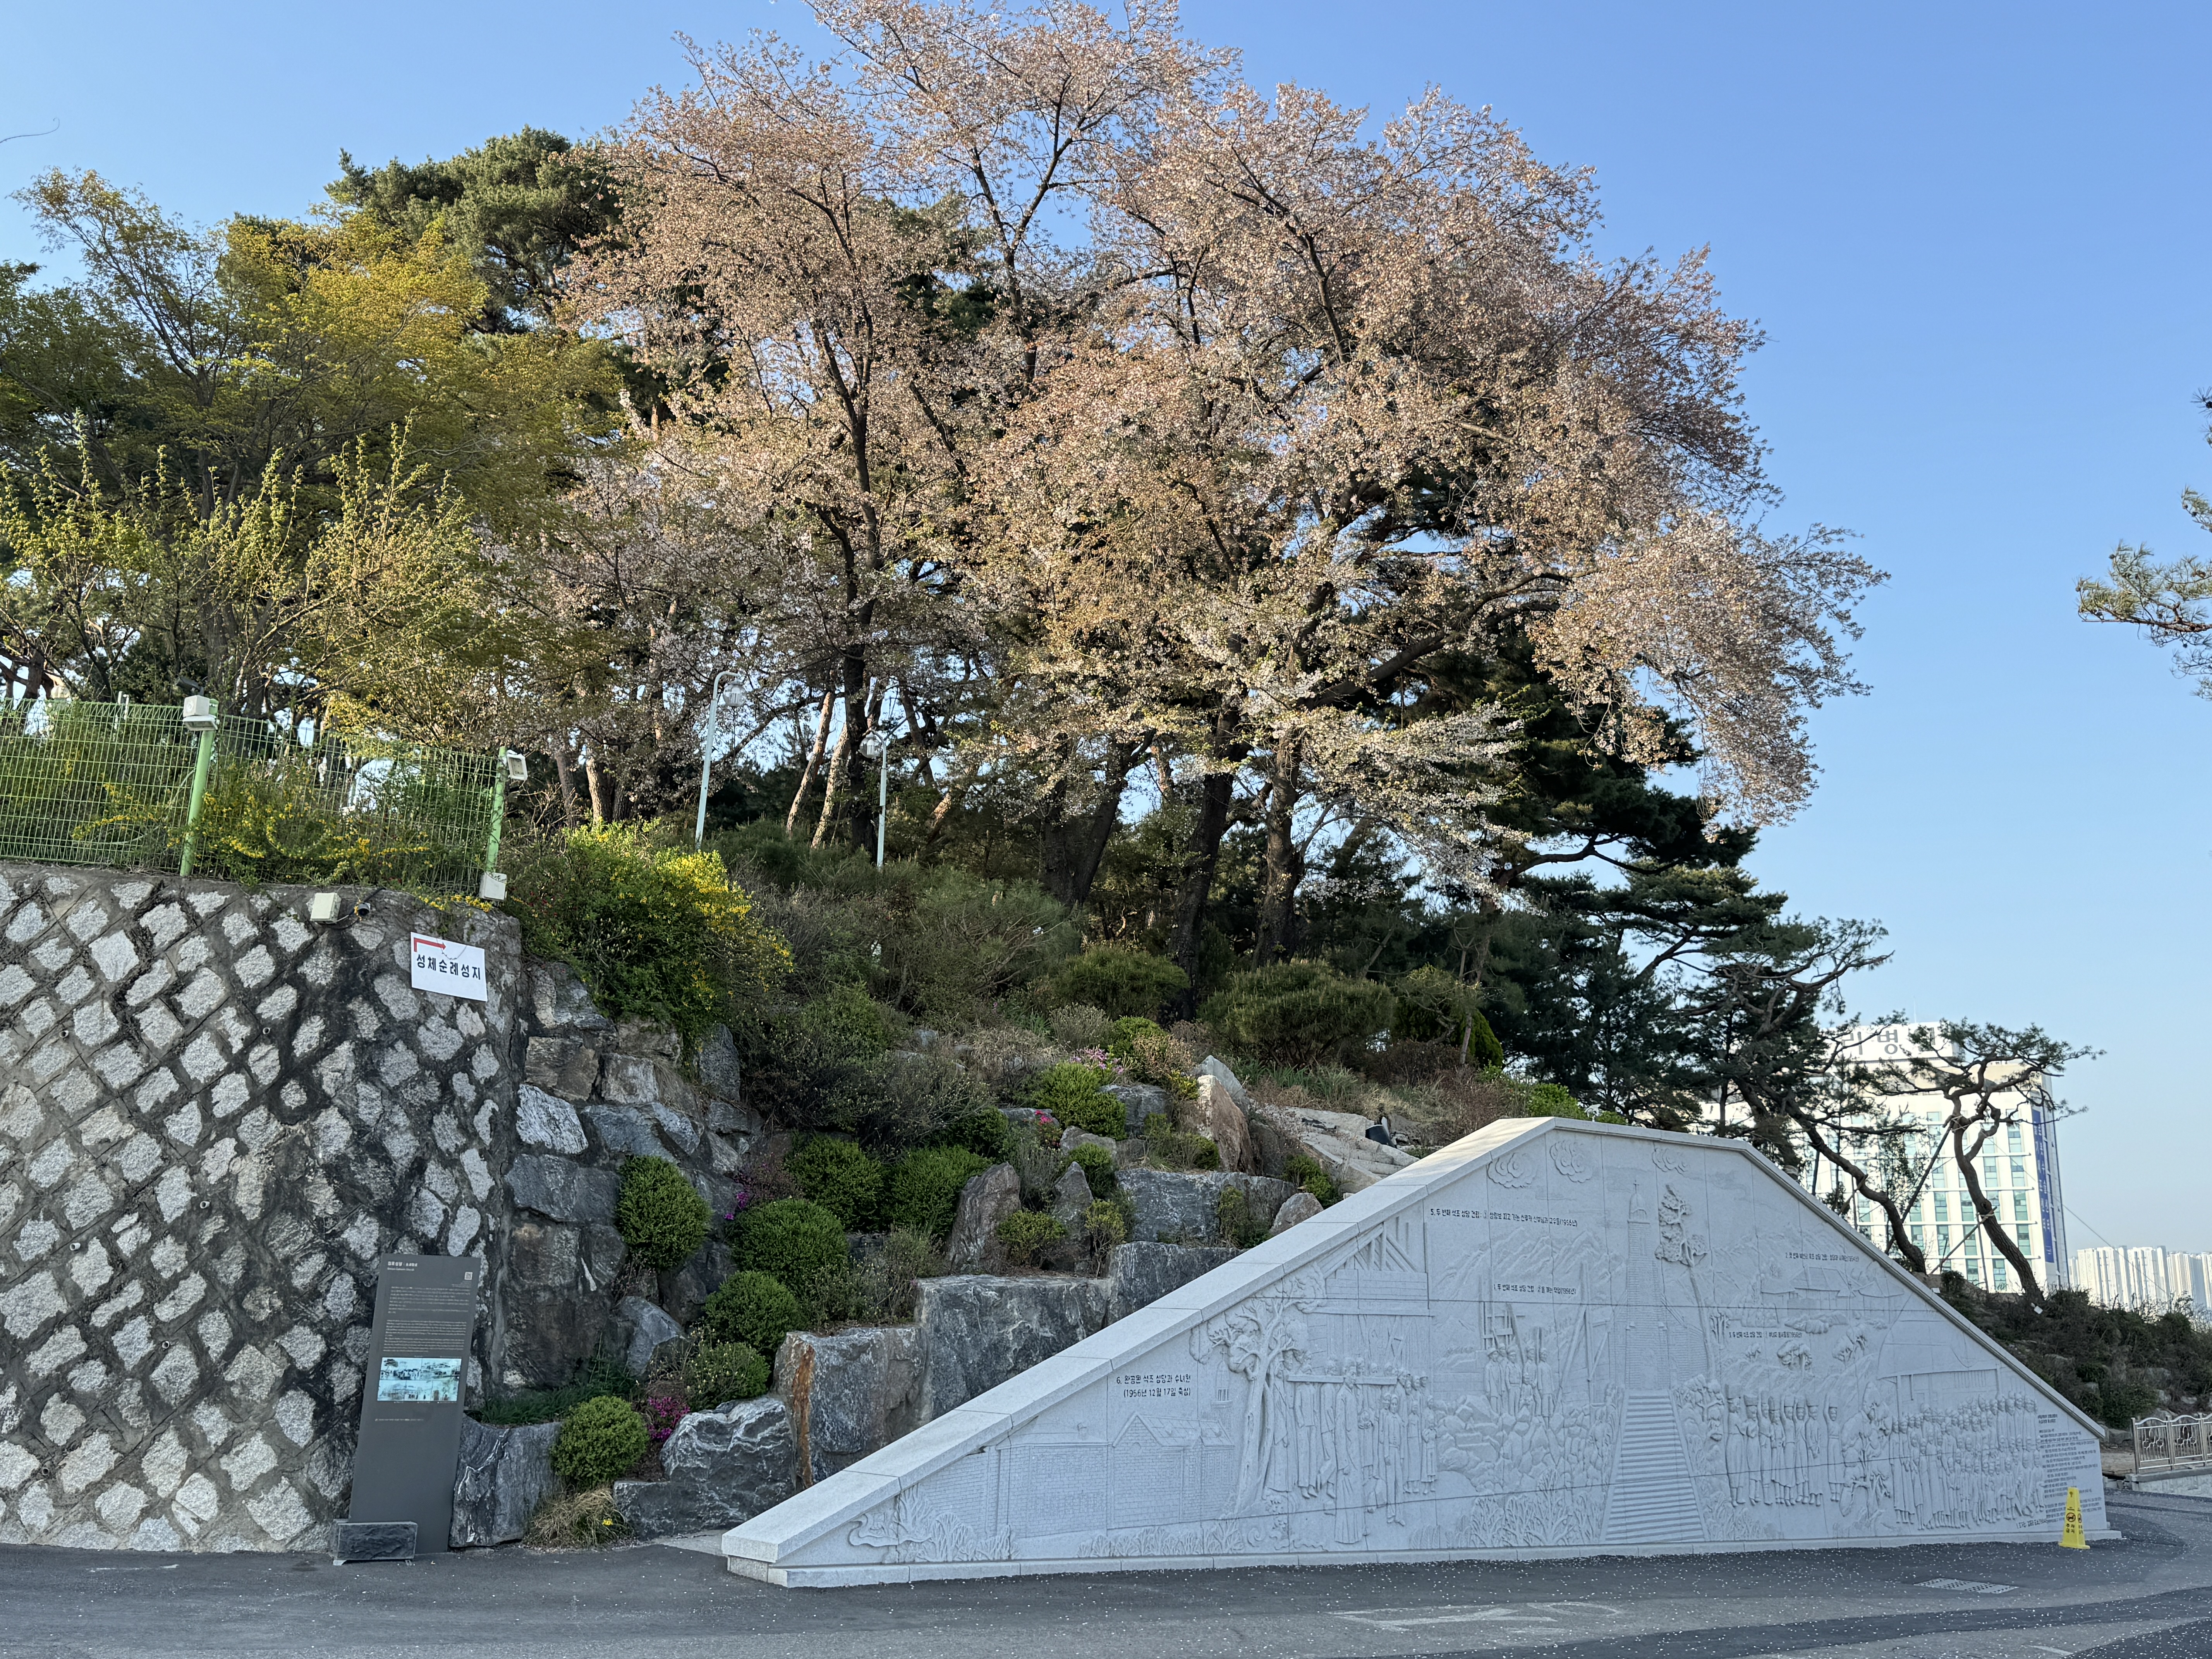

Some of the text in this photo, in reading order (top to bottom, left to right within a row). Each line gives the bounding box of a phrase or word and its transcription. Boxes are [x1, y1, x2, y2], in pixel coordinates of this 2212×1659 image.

[417, 954, 481, 980] 성체순례성지
[1124, 1375, 1141, 1384] 완공된
[1143, 1375, 1154, 1383] 석조
[1156, 1374, 1173, 1384] 성당과
[1175, 1374, 1191, 1383] 수녀원
[1123, 1387, 1191, 1398] (1956년 12월 17일 축성)
